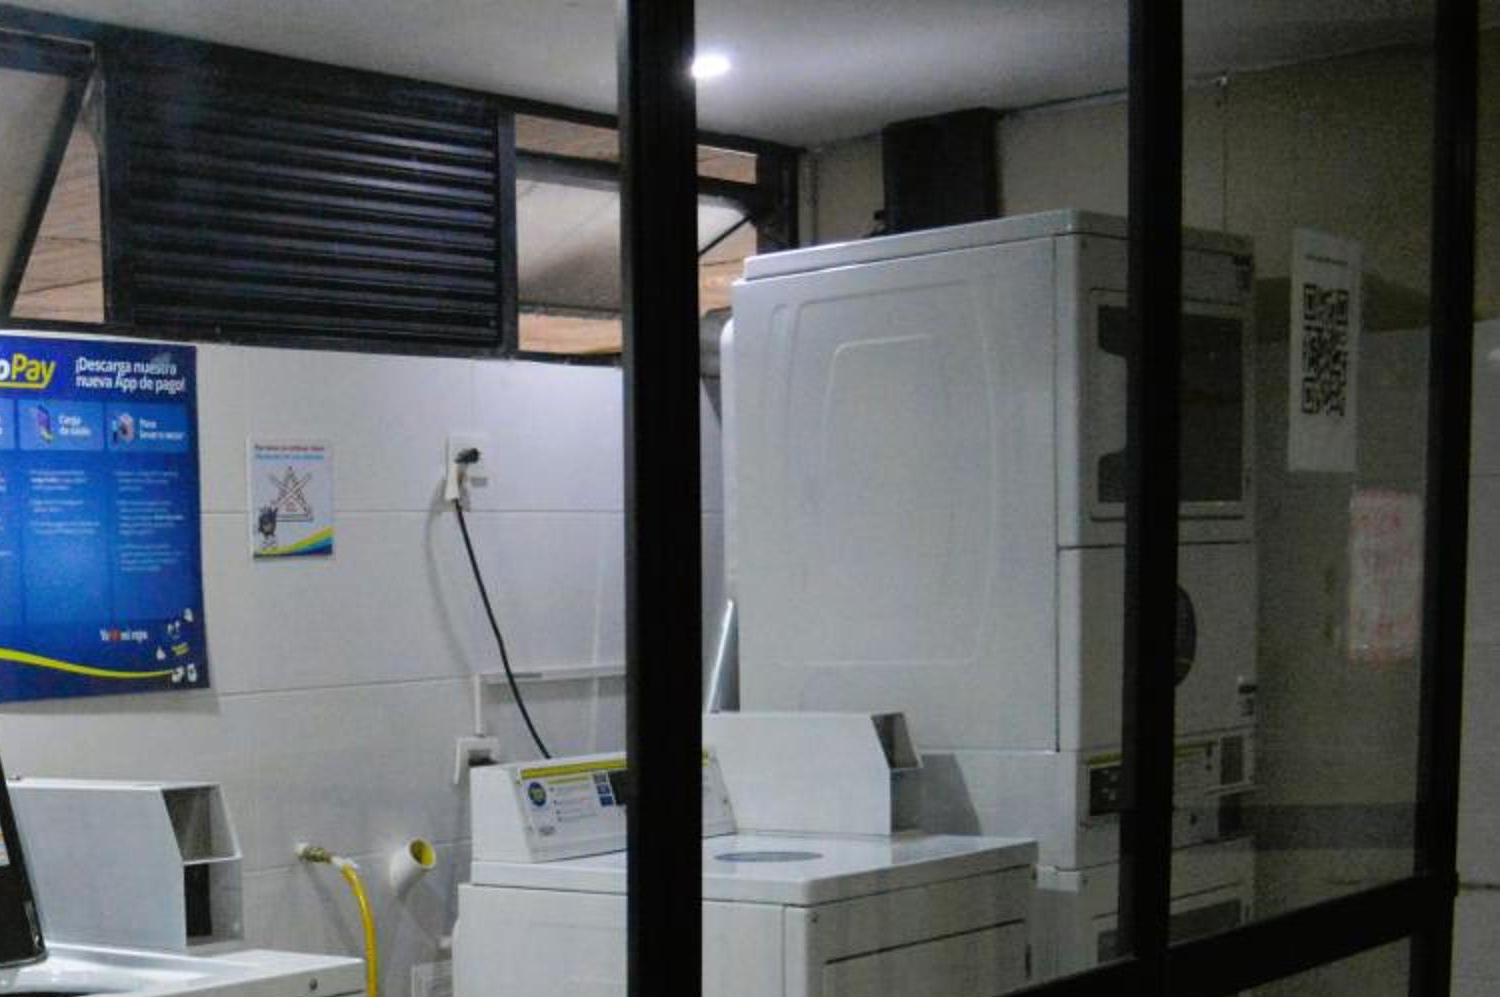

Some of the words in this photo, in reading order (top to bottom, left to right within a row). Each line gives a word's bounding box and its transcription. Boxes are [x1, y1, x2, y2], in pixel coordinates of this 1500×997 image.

[133, 360, 177, 376] nuestra
[76, 376, 112, 388] nueva
[114, 373, 137, 393] App
[139, 376, 153, 390] de
